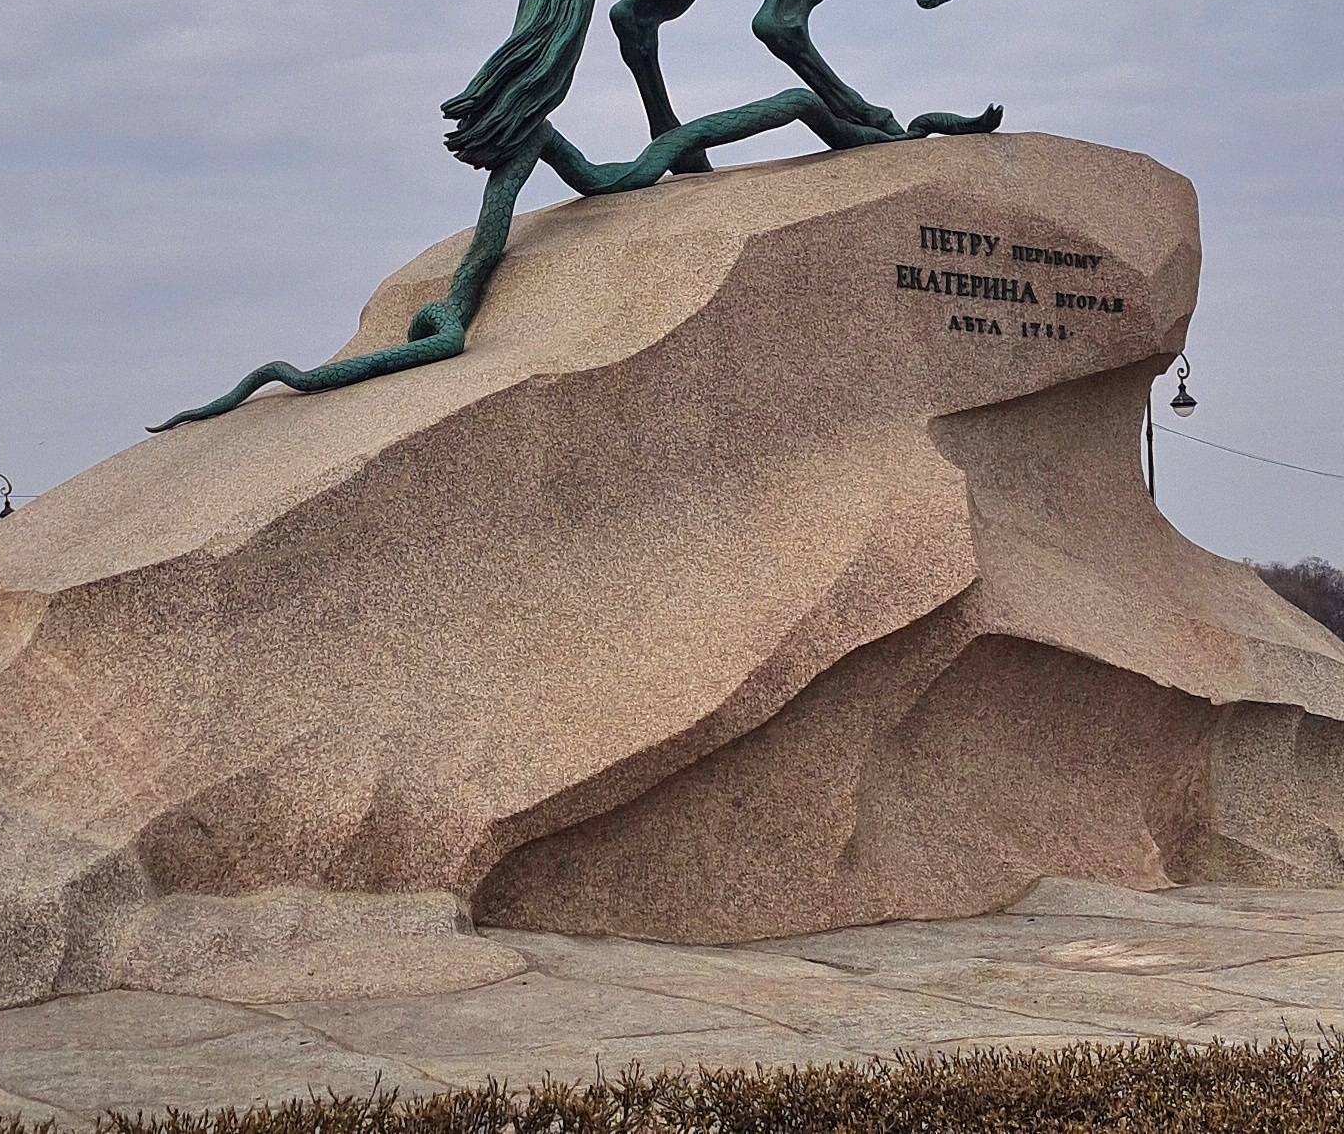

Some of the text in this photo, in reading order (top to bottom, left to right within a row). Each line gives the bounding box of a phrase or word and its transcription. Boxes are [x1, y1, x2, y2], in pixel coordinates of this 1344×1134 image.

[920, 225, 1000, 256] ПЕТРУ
[896, 265, 1124, 313] ЕКАТЕРИНА ВТОРАЯ
